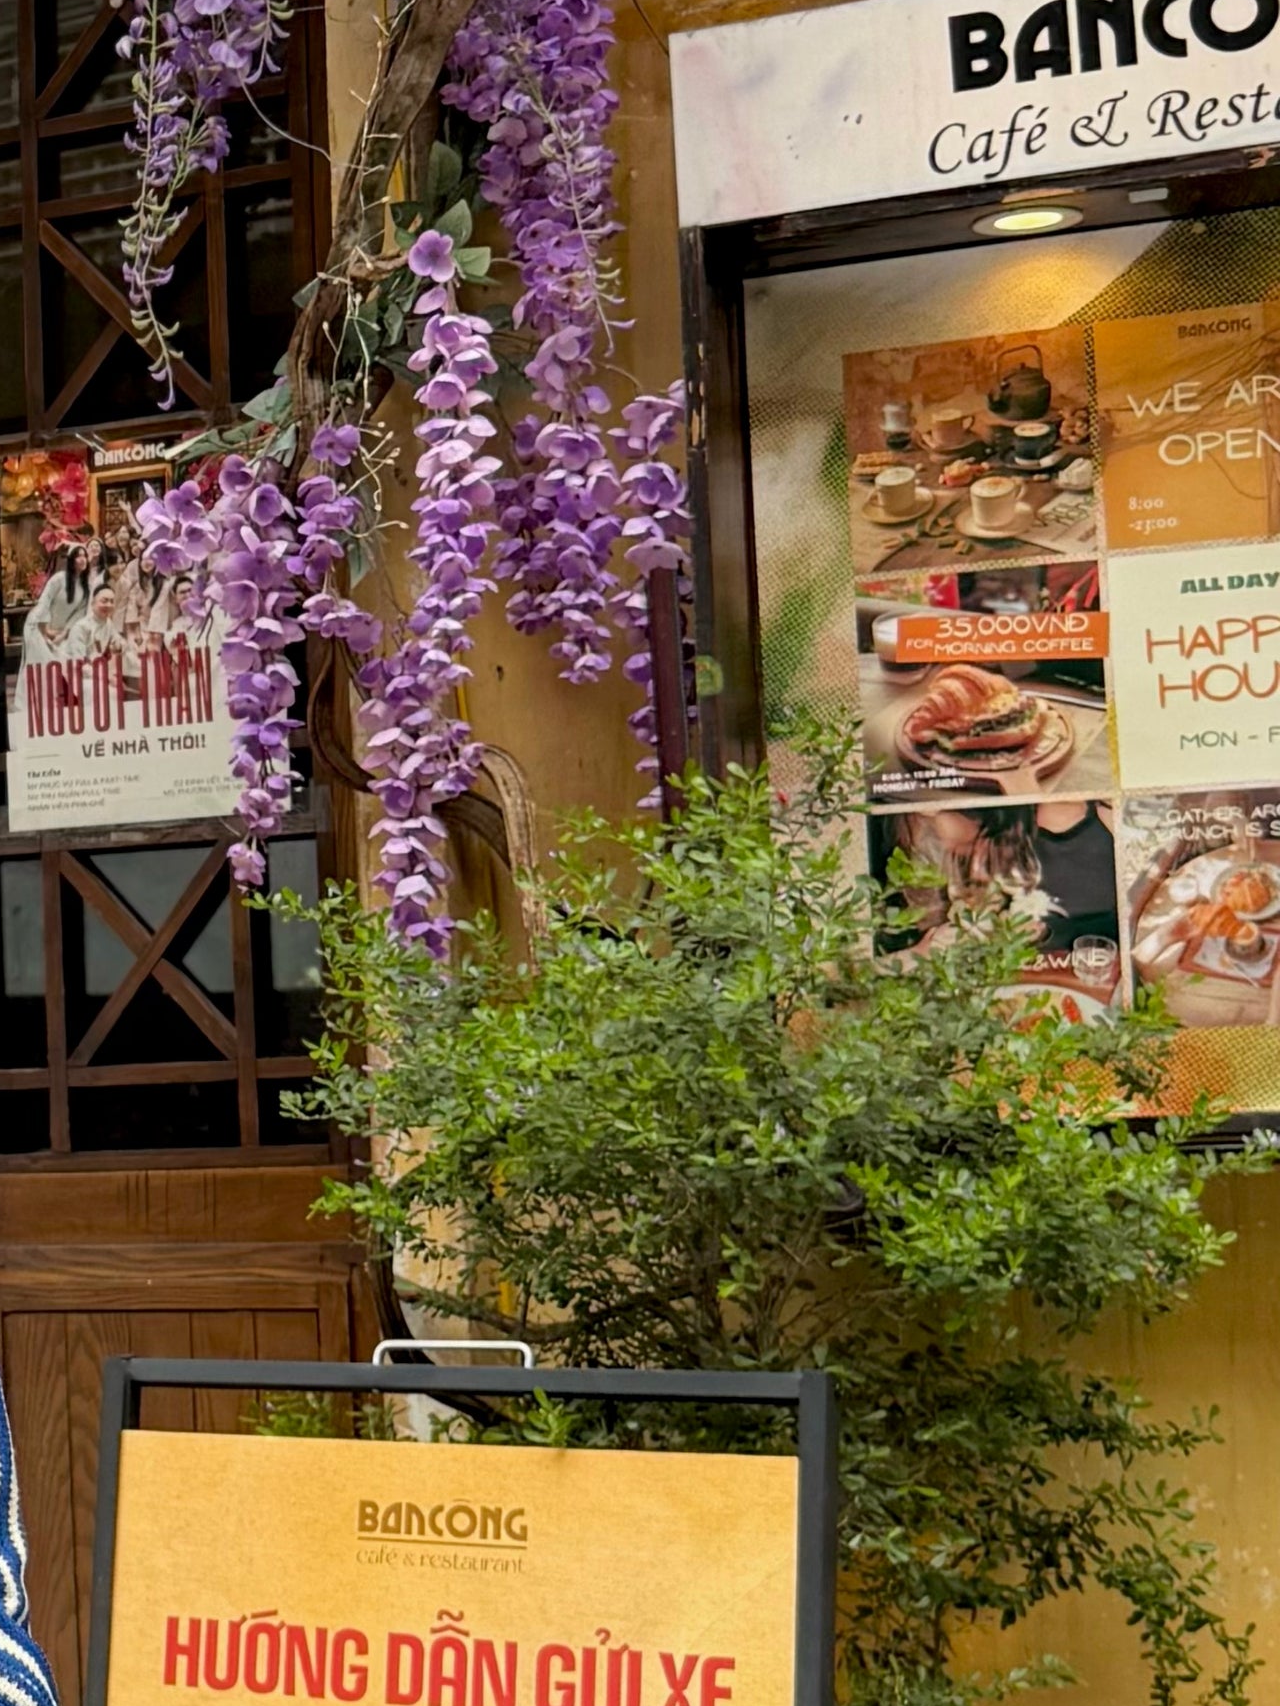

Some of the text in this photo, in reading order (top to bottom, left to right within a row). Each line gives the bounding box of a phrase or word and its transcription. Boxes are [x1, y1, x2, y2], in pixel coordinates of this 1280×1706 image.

[928, 83, 1280, 180] Café & Rest
[1126, 381, 1202, 418] WE
[1180, 571, 1280, 594] ALL DAY
[905, 637, 1095, 656] FOR MORNING COFFEE
[112, 735, 150, 757] NHÀ
[1180, 730, 1238, 750] MON
[928, 777, 965, 789] FRIDAY
[1250, 803, 1280, 819] AR
[356, 1544, 526, 1574] café & restaurant
[163, 1608, 369, 1702] HƯỚNG
